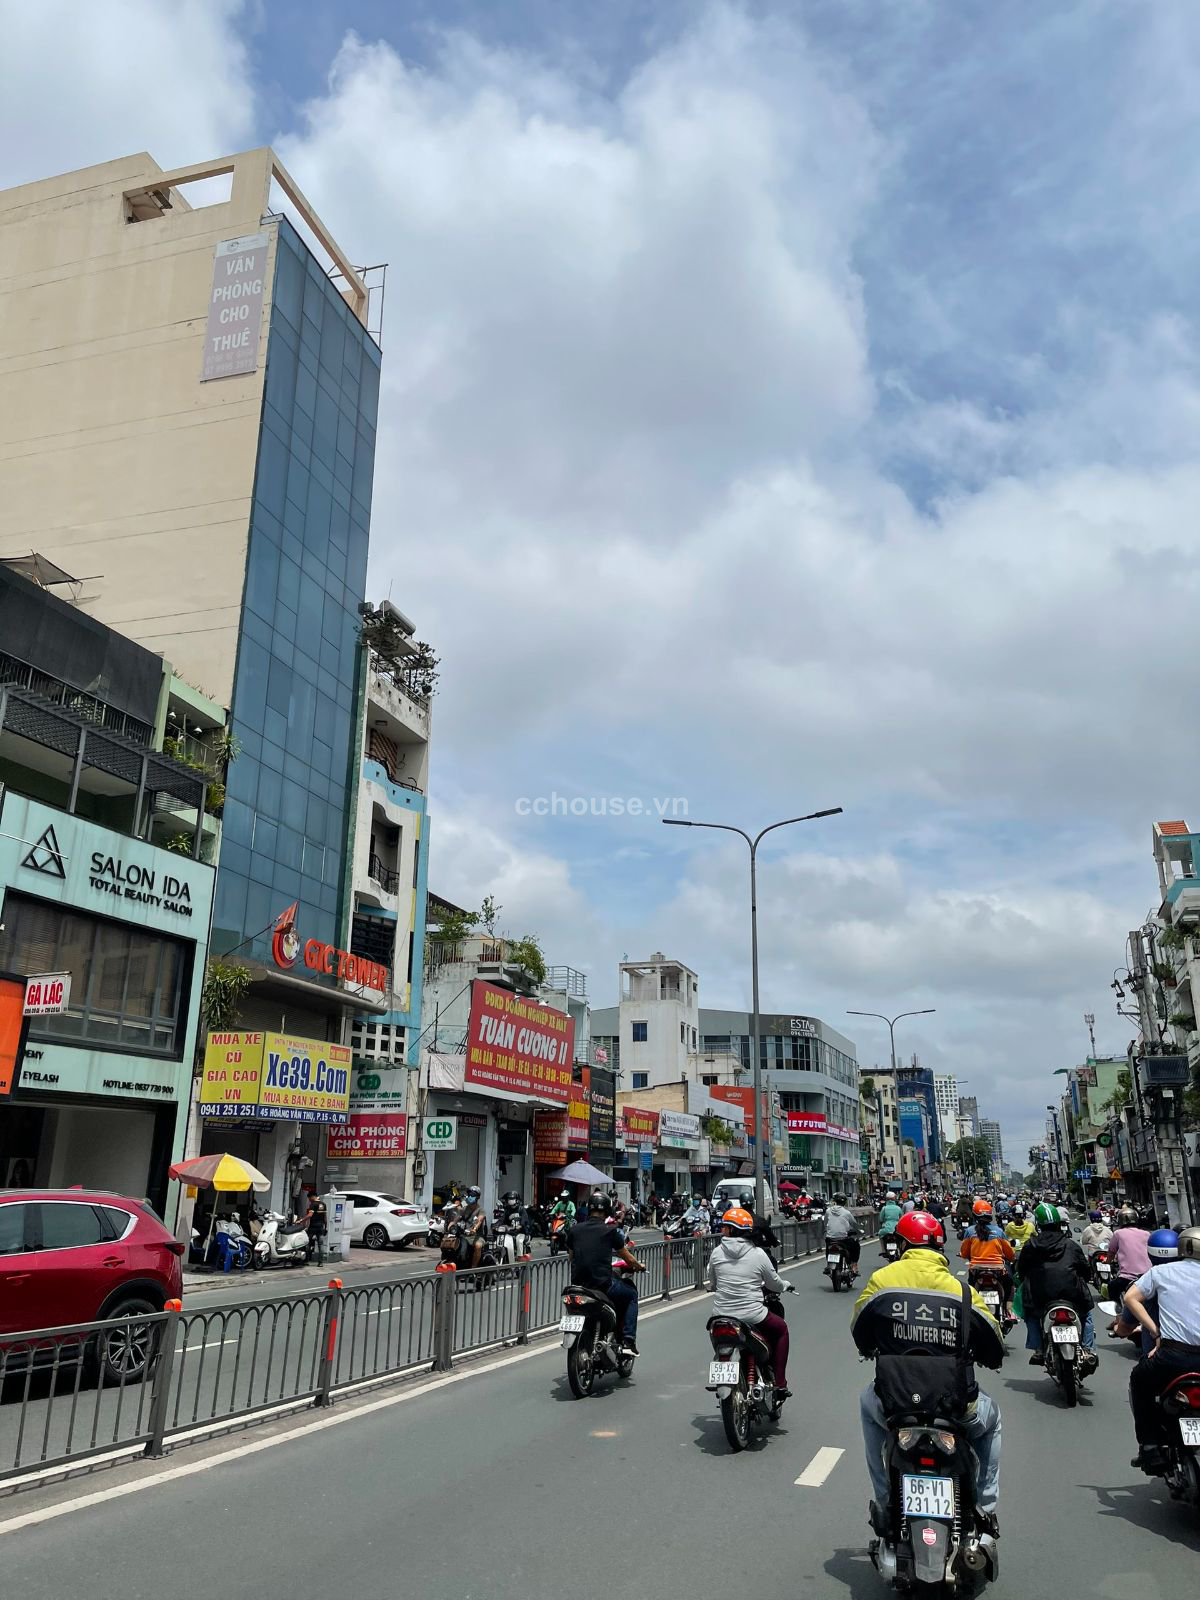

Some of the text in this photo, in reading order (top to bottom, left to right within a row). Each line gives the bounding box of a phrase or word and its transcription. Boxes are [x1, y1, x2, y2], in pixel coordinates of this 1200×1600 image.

[225, 256, 255, 275] VĂN
[212, 279, 262, 304] PHÒNG
[219, 304, 250, 324] CHO
[212, 327, 251, 352] THUÊ
[90, 852, 191, 902] SALON IDA
[89, 876, 193, 917] TOTAL BEAUTY SALON
[336, 949, 388, 993] TOWER
[27, 982, 43, 1007] GÀ
[211, 1033, 261, 1045] MUA XE
[479, 1014, 516, 1050] TUẤN
[23, 1070, 59, 1083] EYELASH
[232, 1070, 258, 1081] CAO
[265, 1053, 348, 1095] Xe39.Com
[103, 1079, 134, 1090] HOTLINE:
[264, 1092, 281, 1104] MUA
[283, 1094, 289, 1104] &
[308, 1096, 319, 1106] XE
[320, 1098, 325, 1107] 2
[200, 1104, 256, 1116] 0941 251 251
[260, 1108, 268, 1117] 45
[269, 1107, 289, 1118] HOÀNG
[290, 1109, 302, 1119] VĂN
[316, 1112, 328, 1121] P.15
[338, 1114, 347, 1122] PN
[900, 1105, 920, 1113] SCB
[330, 1124, 405, 1137] VĂN PHÒNG
[427, 1121, 452, 1139] CED
[789, 1119, 826, 1129] IETFUTURE
[334, 1137, 399, 1150] CHO THUÊ
[893, 1322, 939, 1344] VOLUNTEER
[1186, 1420, 1200, 1431] 59
[1184, 1432, 1200, 1444] 71
[910, 1478, 944, 1497] 66-V1
[906, 1496, 951, 1516] 231.12
